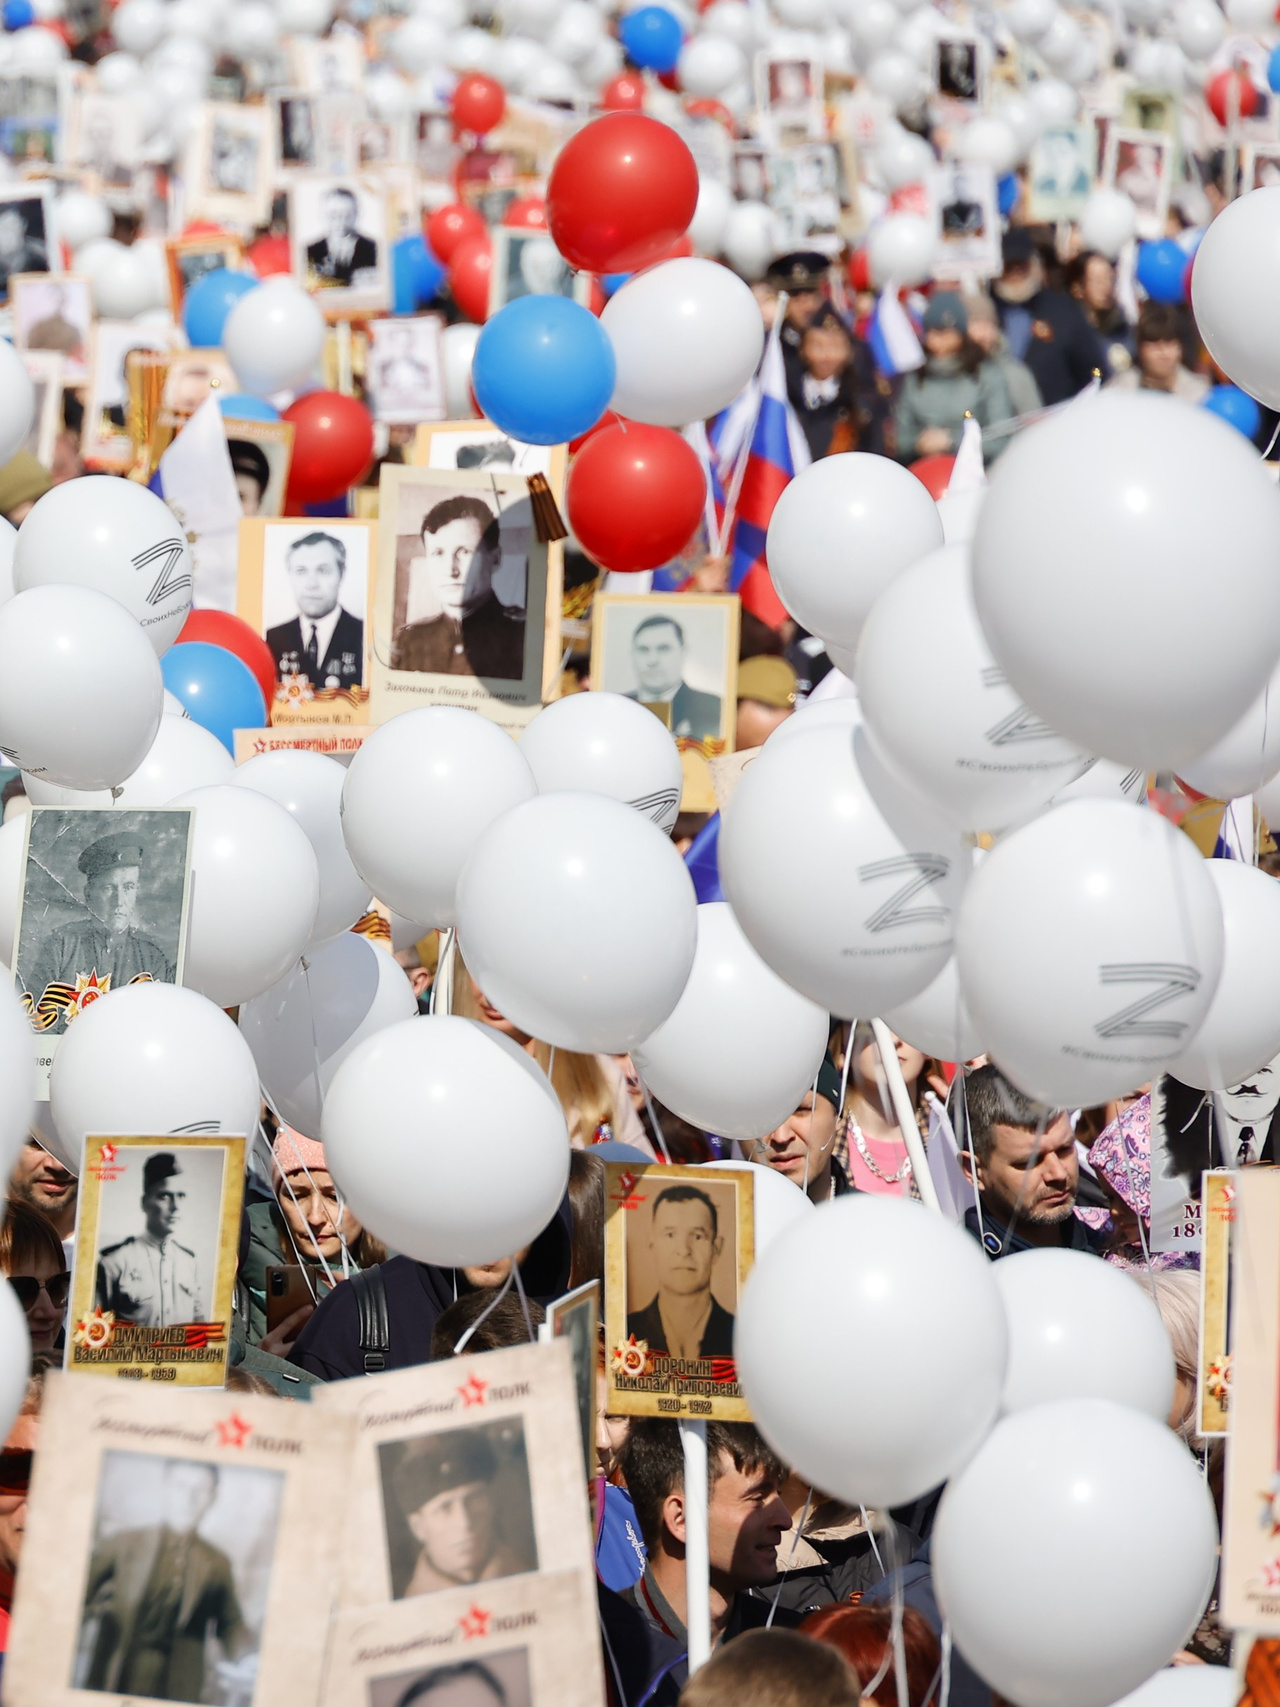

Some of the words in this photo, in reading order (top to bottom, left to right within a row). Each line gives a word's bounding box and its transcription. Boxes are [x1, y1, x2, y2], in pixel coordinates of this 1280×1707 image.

[130, 538, 192, 606] Z
[1172, 1222, 1202, 1238] 18
[113, 1327, 186, 1347] ДМИТРИЕВ
[73, 1345, 133, 1363] Василий
[135, 1346, 223, 1364] Мартынович
[652, 1356, 712, 1377] ДОРОНИН
[615, 1373, 670, 1393] Николай
[672, 1376, 744, 1397] Григорьеви
[658, 1399, 680, 1412] 1920
[689, 1400, 712, 1414] 1972
